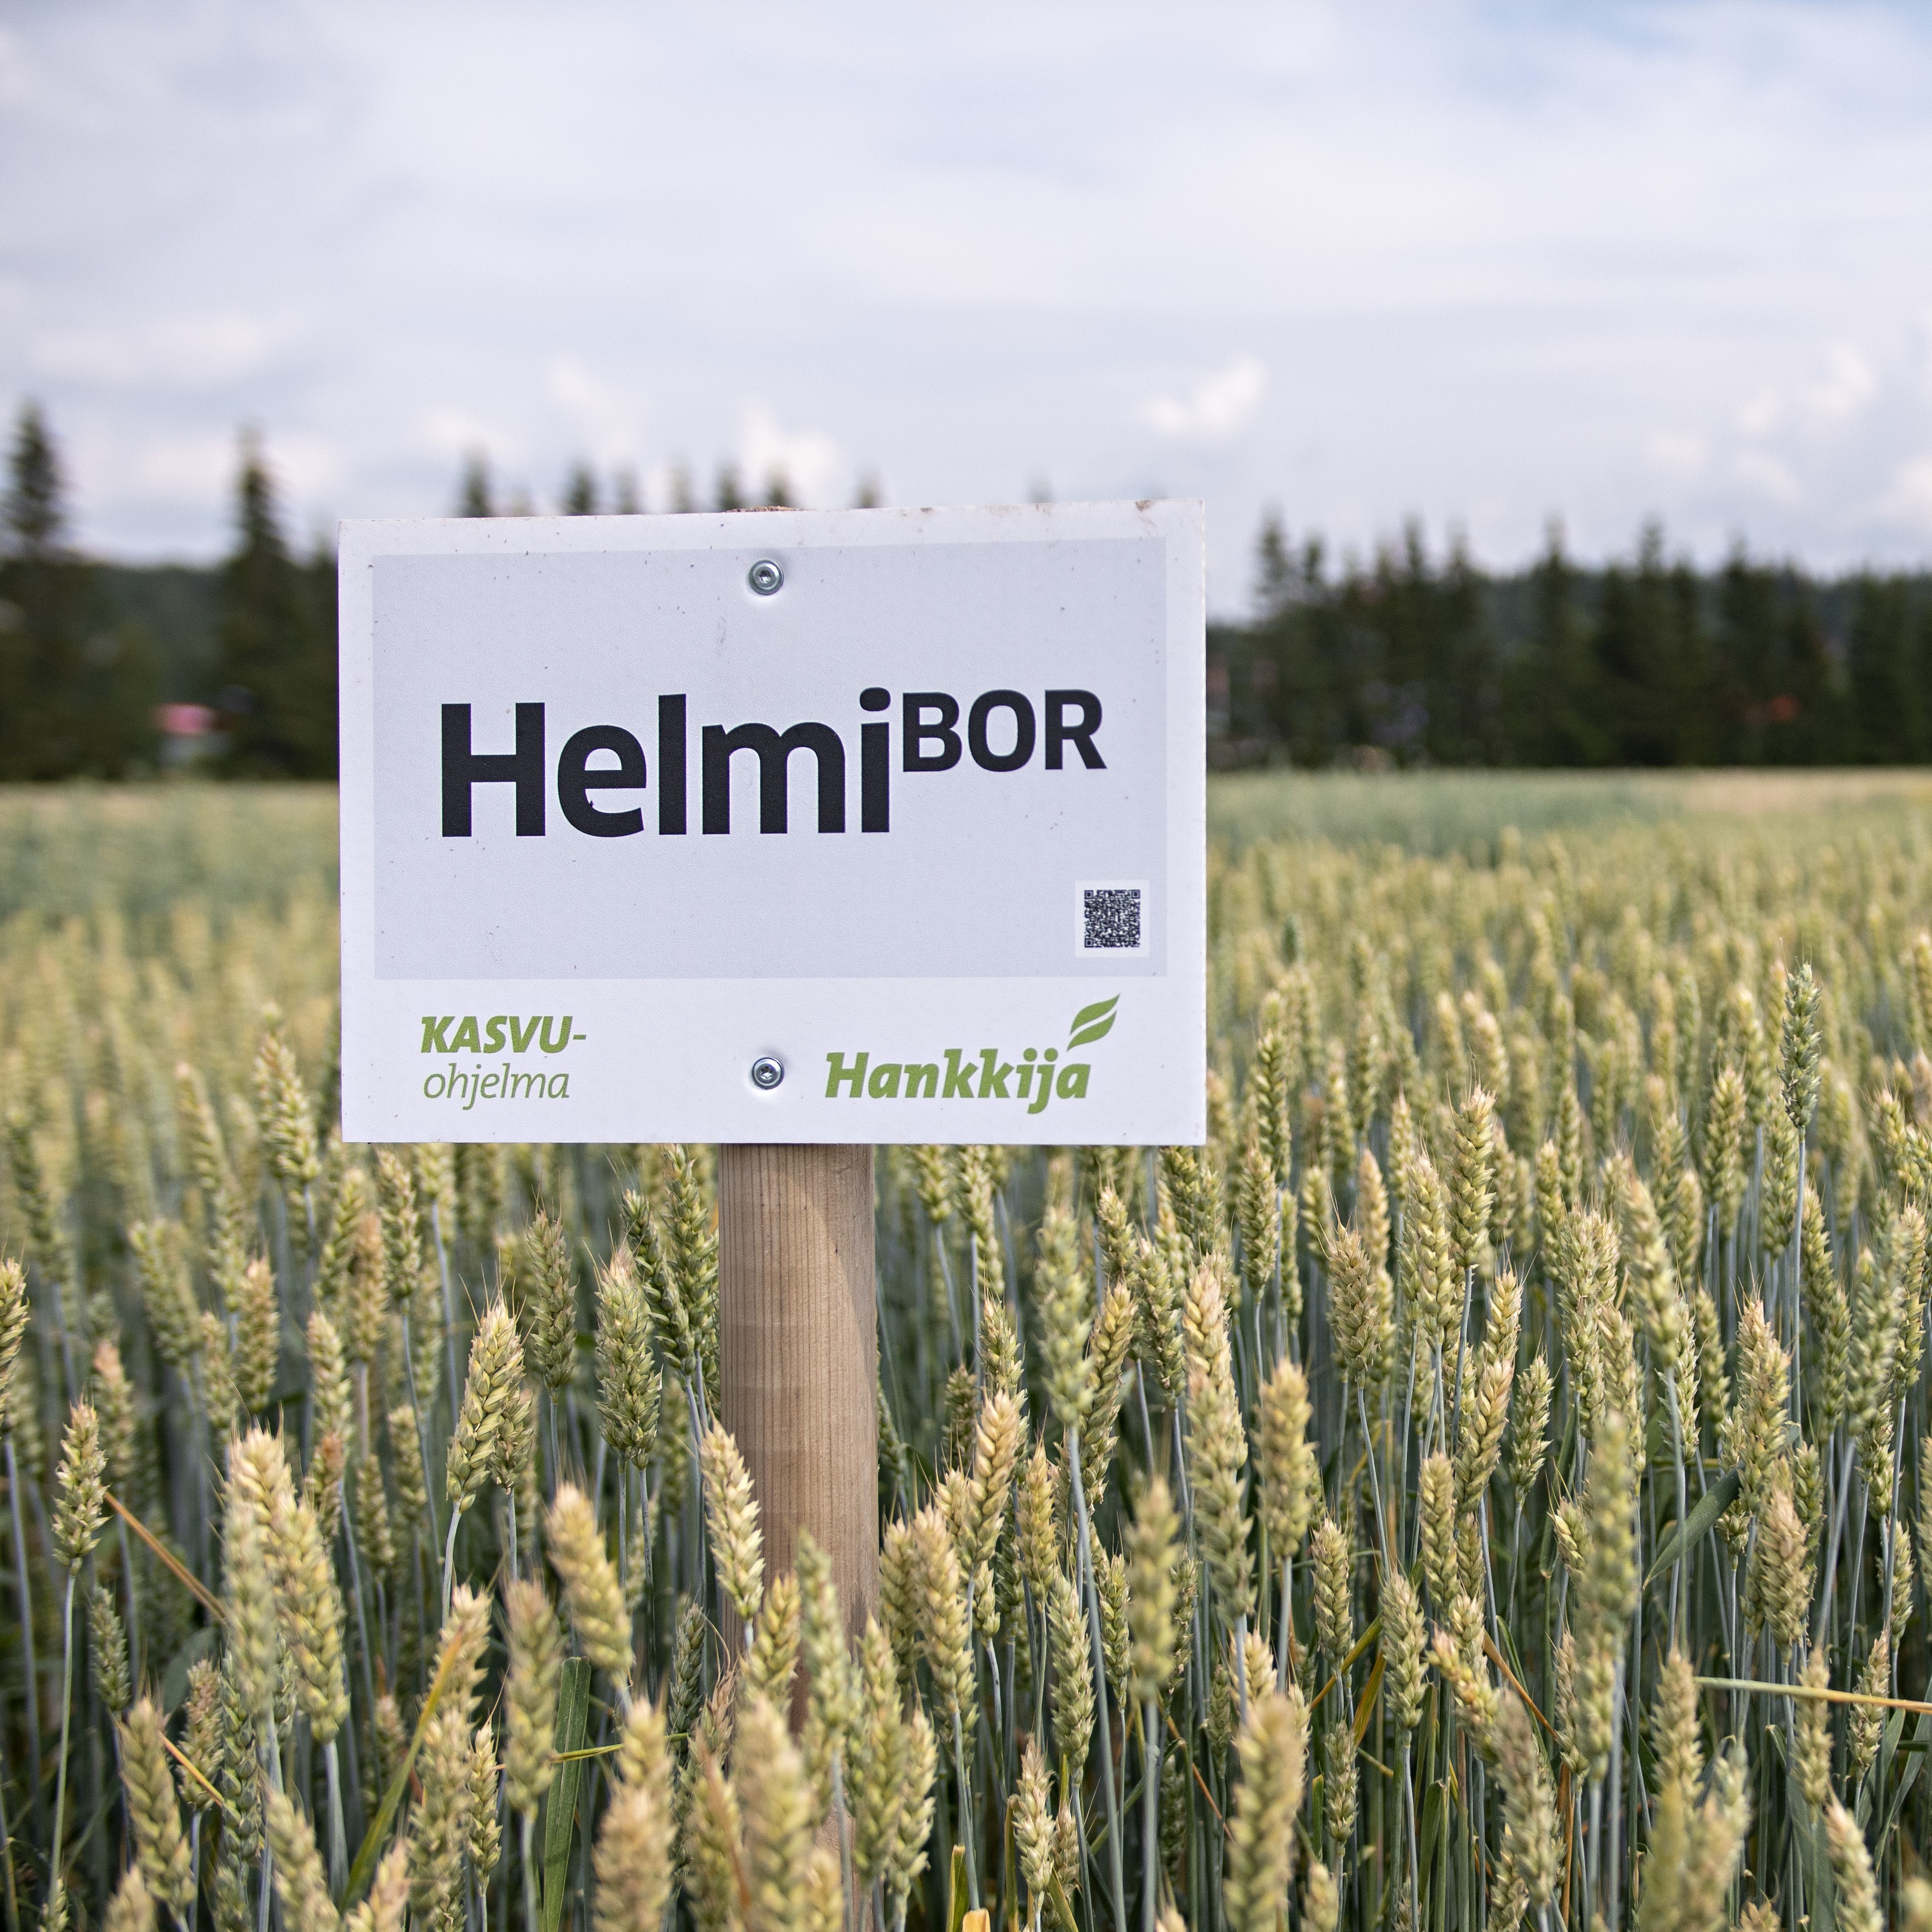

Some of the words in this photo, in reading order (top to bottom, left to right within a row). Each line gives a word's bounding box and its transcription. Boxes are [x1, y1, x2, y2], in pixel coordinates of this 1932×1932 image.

[421, 1016, 587, 1053] KASVU-
[423, 1062, 570, 1111] ohjelma
[825, 1047, 1092, 1114] Hankkija
